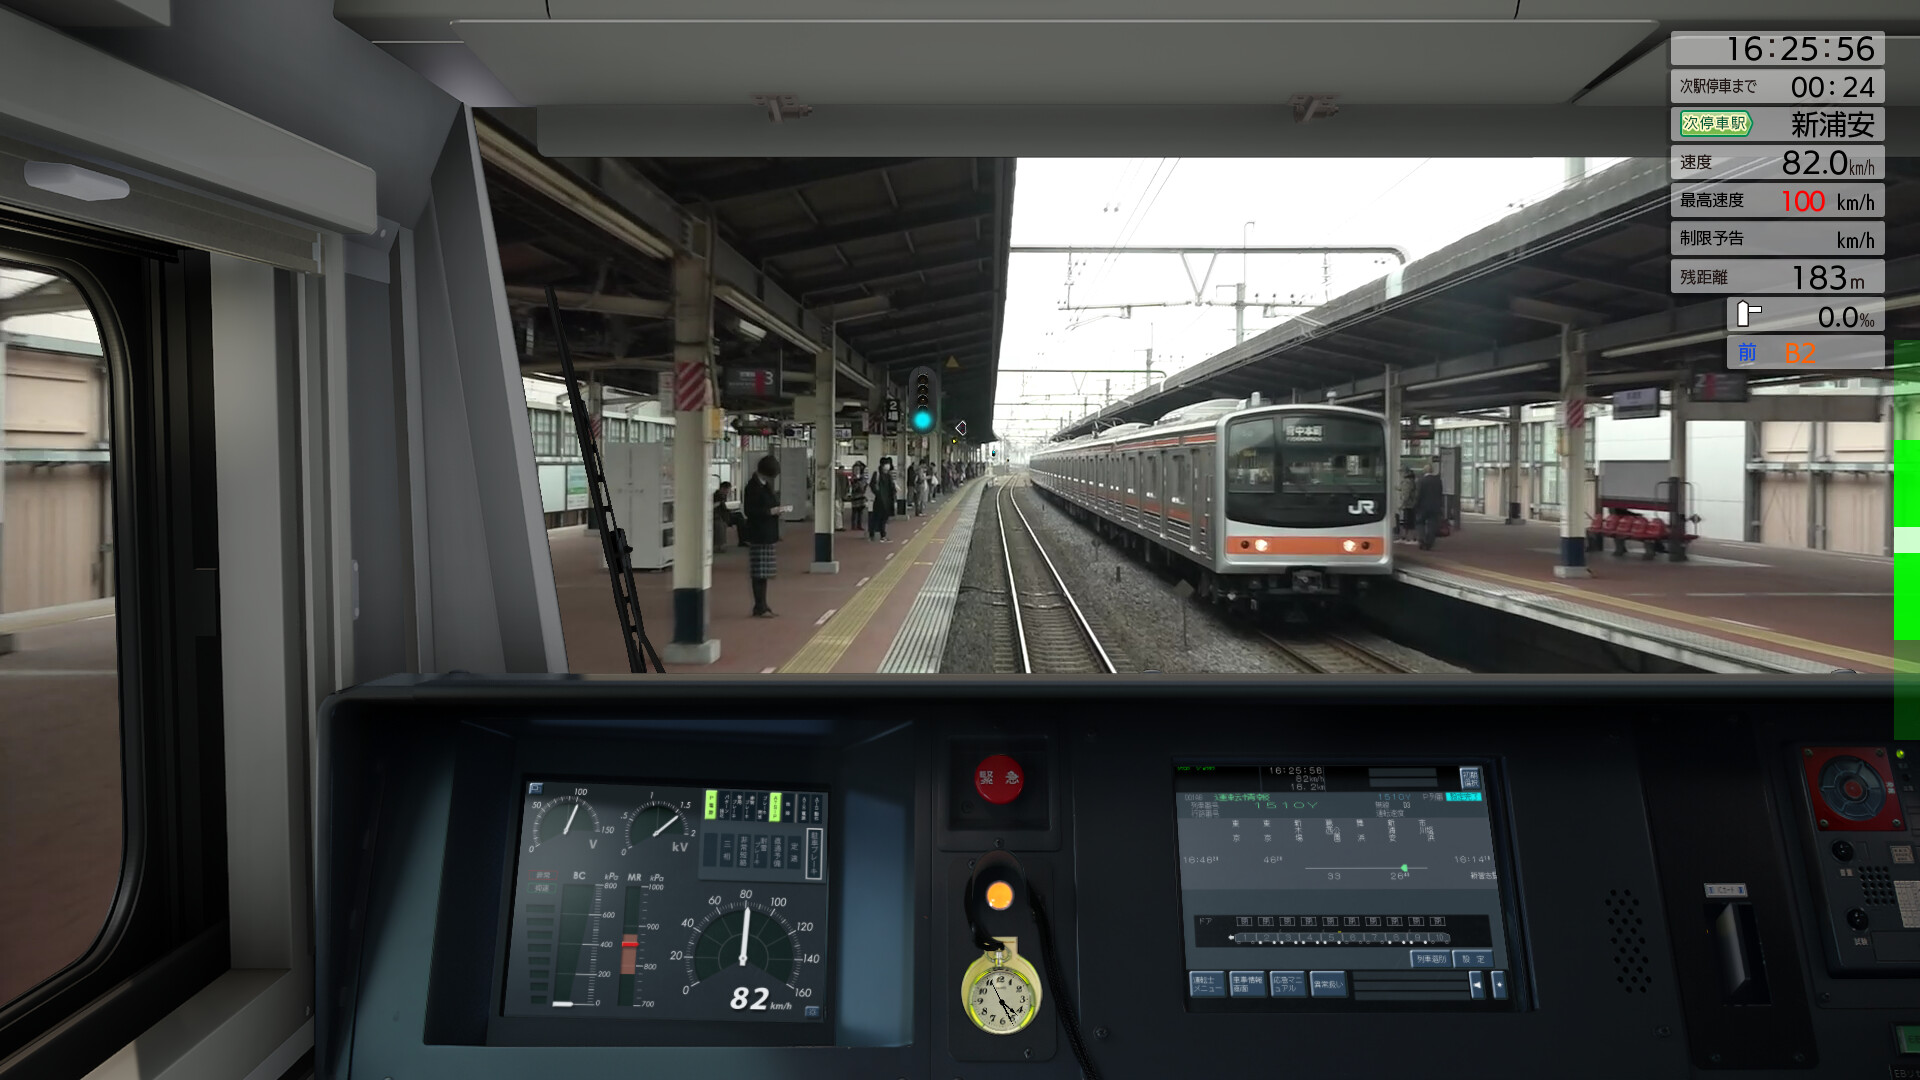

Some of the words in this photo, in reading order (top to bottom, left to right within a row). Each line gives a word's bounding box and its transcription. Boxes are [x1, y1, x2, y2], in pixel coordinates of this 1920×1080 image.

[889, 401, 898, 410] 2
[1348, 500, 1375, 515] JR
[979, 770, 1019, 785] 緊急
[574, 788, 588, 796] 100
[680, 801, 691, 809] 1.5
[601, 826, 614, 834] 150
[690, 829, 696, 837] 2
[589, 839, 598, 849] V
[672, 843, 688, 852] kV
[811, 831, 819, 875] 駐車ブレーキ
[572, 872, 586, 880] BC
[604, 872, 619, 880] kPa
[628, 874, 641, 882] MR
[650, 874, 664, 882] kPa
[1327, 872, 1341, 880] 33
[740, 889, 753, 899] 80
[708, 895, 721, 905] 60
[770, 897, 787, 907] 100
[646, 923, 660, 931] 900
[681, 918, 694, 928] 40
[797, 922, 814, 932] 120
[670, 952, 683, 961] 20
[802, 954, 820, 964] 140
[683, 985, 690, 995] 0
[795, 988, 812, 998] 160
[1015, 985, 1022, 993] 2
[730, 987, 770, 1011] 82
[770, 1002, 792, 1011] km/h
[1020, 995, 1026, 1003] 3
[981, 1007, 988, 1015] 8
[989, 1014, 996, 1022] 7
[1000, 1017, 1006, 1025] 6
